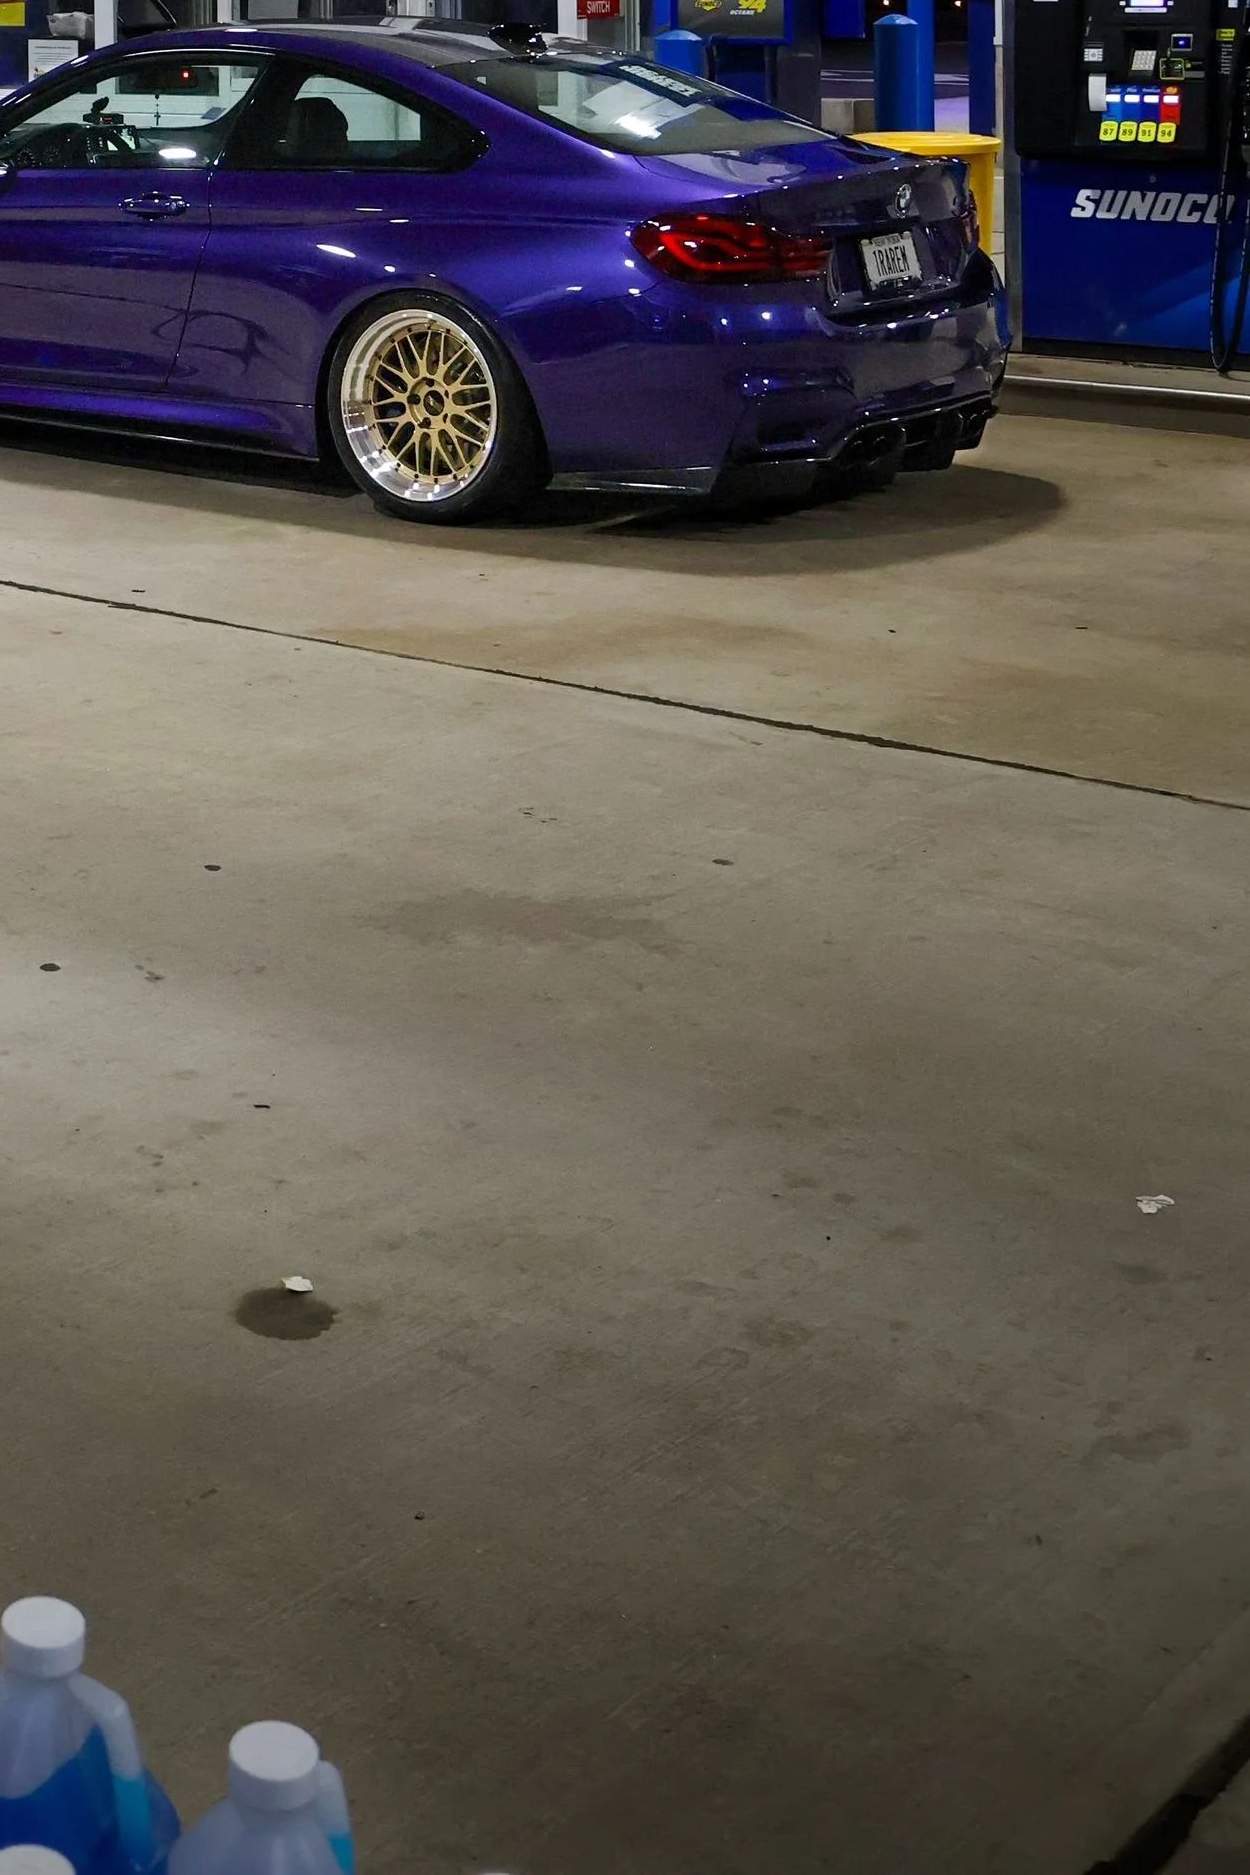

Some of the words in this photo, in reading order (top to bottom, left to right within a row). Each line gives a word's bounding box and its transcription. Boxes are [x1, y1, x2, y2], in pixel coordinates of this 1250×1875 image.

[586, 0, 611, 14] SWITCH
[1102, 128, 1114, 136] 87
[1122, 128, 1134, 136] 89
[1141, 129, 1152, 137] 91
[1161, 130, 1172, 138] 94
